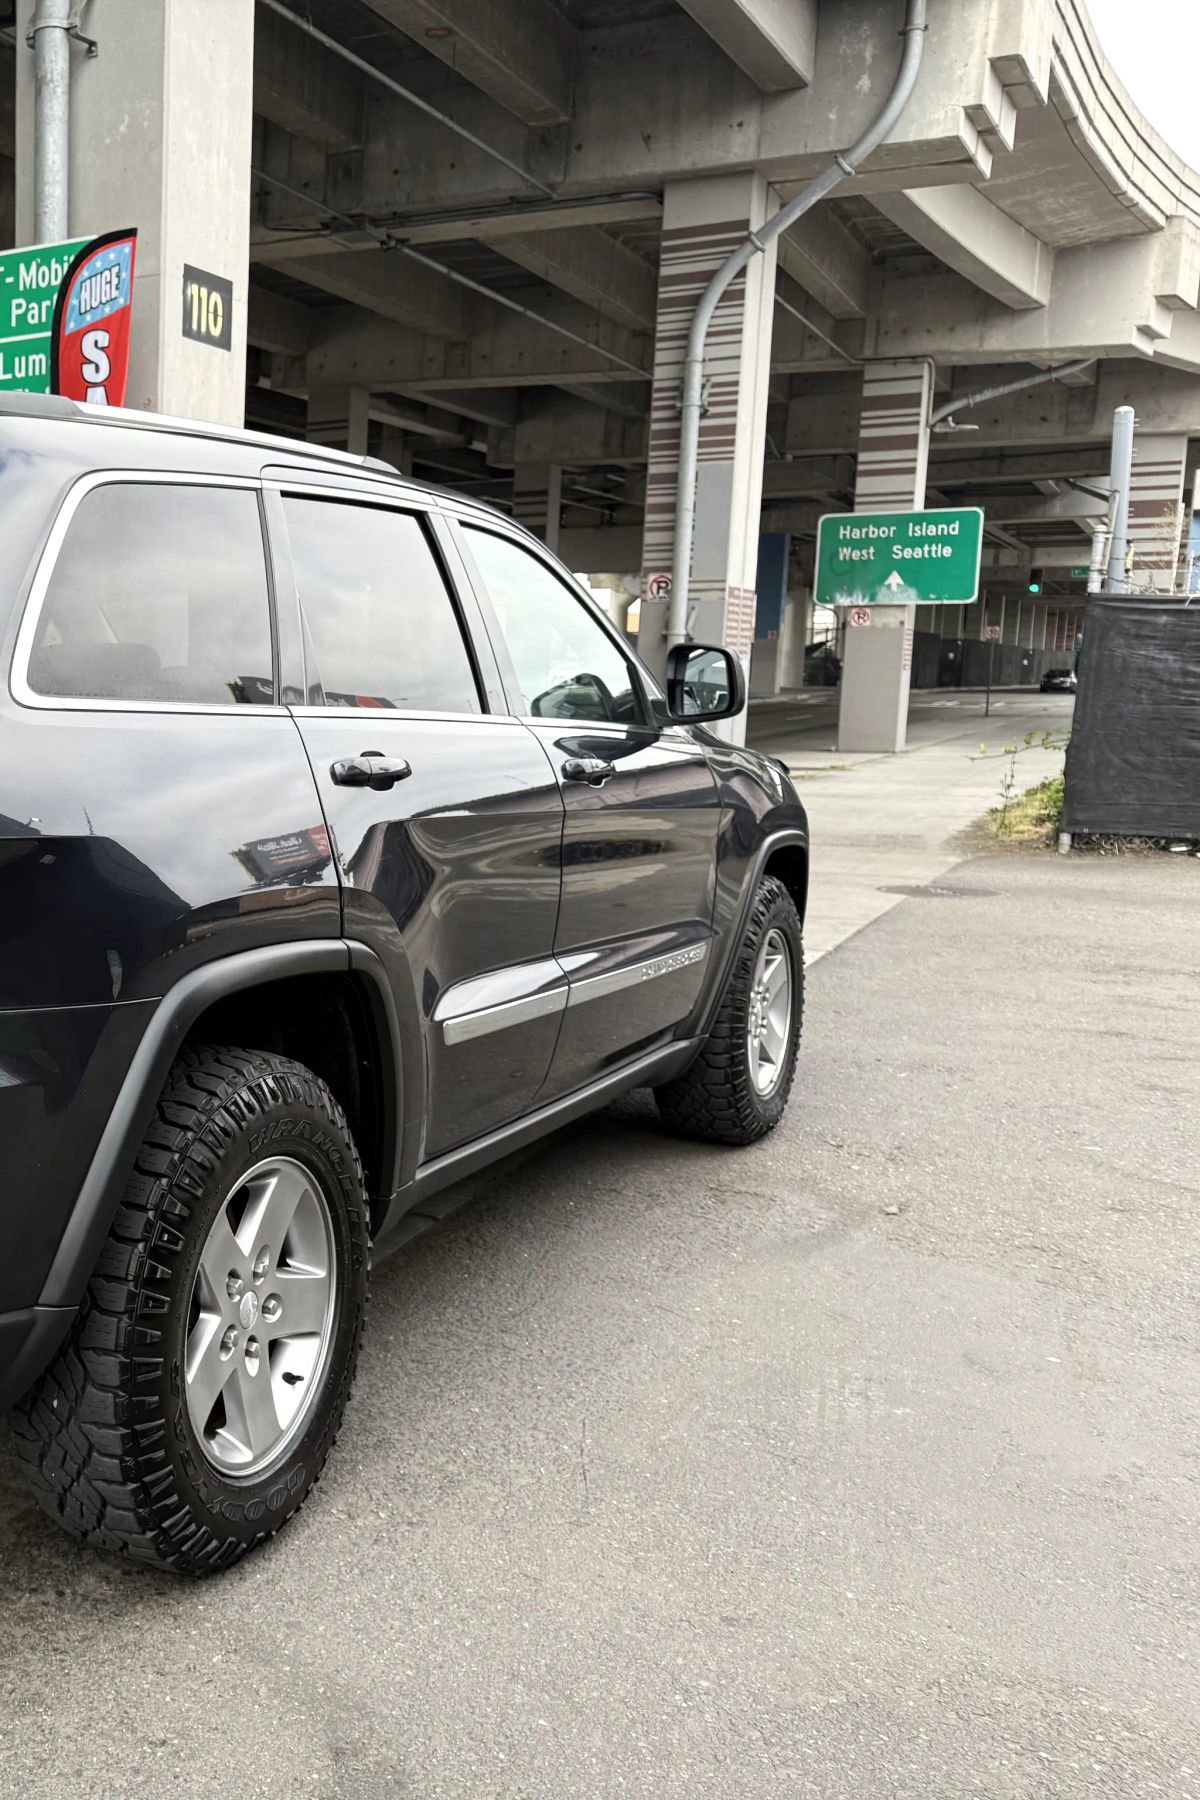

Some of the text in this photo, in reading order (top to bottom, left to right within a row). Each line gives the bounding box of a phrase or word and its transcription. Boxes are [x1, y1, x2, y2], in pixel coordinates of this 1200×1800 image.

[79, 262, 121, 316] HUGE
[11, 293, 58, 327] Par
[191, 283, 224, 338] 110
[0, 352, 51, 380] Lum
[838, 520, 960, 540] Harbor Island
[838, 543, 953, 561] West Seattle
